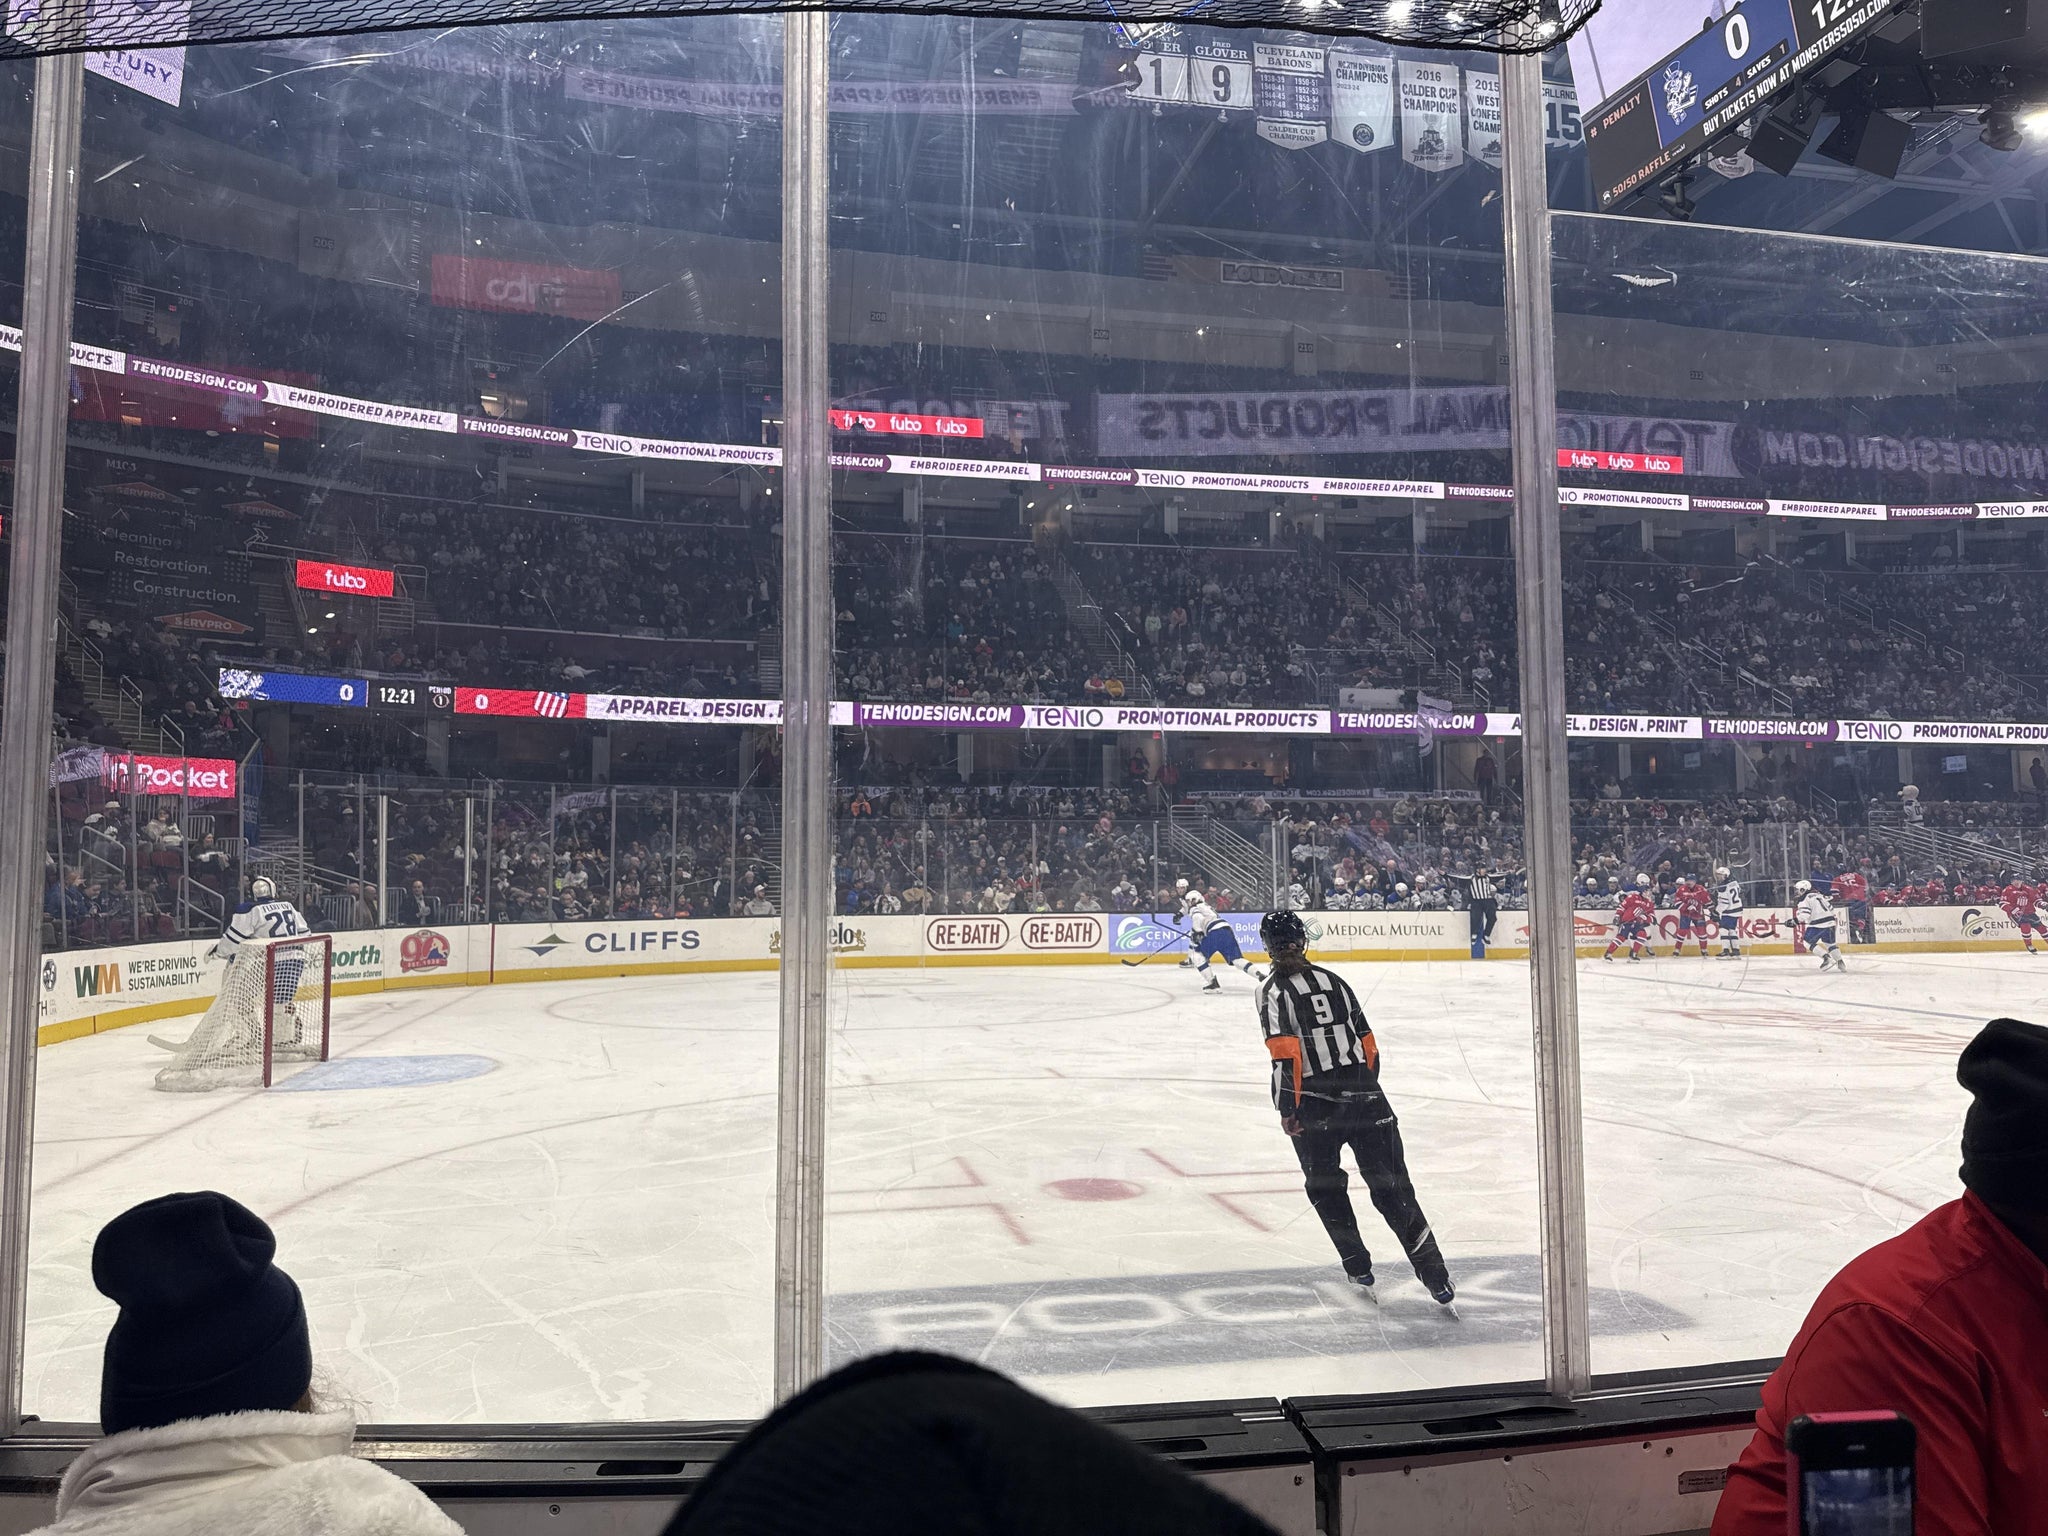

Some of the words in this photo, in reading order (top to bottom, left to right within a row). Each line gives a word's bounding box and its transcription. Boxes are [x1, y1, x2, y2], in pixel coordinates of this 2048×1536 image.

[1725, 13, 1749, 60] 0
[1195, 46, 1248, 59] GLOVER
[1257, 46, 1322, 60] CLEVELAND
[1268, 57, 1312, 69] BARONS
[1359, 63, 1386, 73] DIVISION
[1747, 55, 1771, 79] SAVES
[1150, 58, 1162, 96] 1
[1212, 65, 1232, 102] 9
[1336, 69, 1388, 84] CHAMPIONS
[1416, 69, 1441, 82] 2016
[1402, 83, 1437, 98] CALDER
[1439, 87, 1457, 99] CUP
[1477, 95, 1500, 107] WEST
[1704, 87, 1728, 110] SHOTS
[1735, 76, 1742, 87] 4
[1404, 98, 1457, 114] CHAMPIONS
[1602, 93, 1641, 129] PENALTY
[1702, 116, 1720, 137] BUY
[1720, 91, 1756, 123] TICKETS
[1757, 77, 1777, 98] NOW
[1780, 69, 1790, 83] AT
[1471, 108, 1500, 120] CONFER
[1546, 102, 1582, 141] 15
[1268, 125, 1298, 134] CALDER
[1300, 128, 1316, 136] CUP
[1473, 120, 1500, 133] CHAMP
[1269, 132, 1316, 143] CHAMPIONS
[1612, 175, 1637, 198] 50/50
[1638, 151, 1671, 180] RAFFLE
[132, 360, 258, 395] TEN10DESIGN.COM
[288, 391, 383, 417] EMBROIDERED
[385, 409, 443, 425] APPAREL
[462, 419, 569, 443] TEN10DESIGN.COM
[640, 443, 717, 458] PROMOTIONAL
[718, 449, 774, 461] PRODUCTS
[890, 416, 922, 431] fubo
[936, 419, 967, 434] fubo
[1571, 453, 1597, 466] fubo
[1608, 455, 1634, 469] fubo
[1644, 457, 1670, 471] fubo
[910, 461, 983, 474] EMBROIDERED
[984, 464, 1030, 475] APPAREL
[1045, 469, 1132, 482] TEN10DESIGN.COM
[1192, 476, 1259, 489] PROMOTIONAL
[1260, 479, 1309, 490] PRODUCTS
[1324, 481, 1391, 494] EMBROIDERED
[1392, 484, 1434, 494] APPAREL
[1449, 487, 1514, 499] TEN10DESIGN.C
[1583, 493, 1639, 504] PROMOTIONAL
[1641, 497, 1682, 507] PRODUCTS
[1692, 499, 1763, 511] TEN10DESIGN.COM
[1781, 503, 1838, 515] EMBROIDERED
[1840, 506, 1877, 516] APPAREL
[1890, 506, 1973, 518] TEN10DESIGN.COM
[325, 569, 366, 590] fubo
[175, 616, 232, 631] SERVPRO
[340, 684, 353, 700] 0
[380, 688, 415, 704] 12:21
[475, 694, 488, 709] 0
[606, 699, 689, 717] APPAREL
[702, 702, 764, 718] DESIGN
[862, 705, 1011, 722] TEN10DESIGN.COM
[1118, 710, 1232, 727] PROMOTIONAL
[1235, 713, 1317, 728] PRODUCTS
[1589, 718, 1638, 733] DESIGN
[1647, 719, 1687, 733] PRINT
[1708, 720, 1828, 736] TEN10DESIGN.COM
[1913, 725, 2004, 740] PROMOTIONAL
[2006, 727, 2048, 740] PRODU
[137, 763, 228, 789] Rocket
[265, 910, 296, 937] 28
[585, 929, 701, 953] CLIFFS
[158, 956, 197, 970] DRIVING
[75, 963, 122, 998] WM
[128, 971, 201, 991] SUSTAINABILITY
[363, 969, 382, 978] stores
[1310, 994, 1334, 1024] 9
